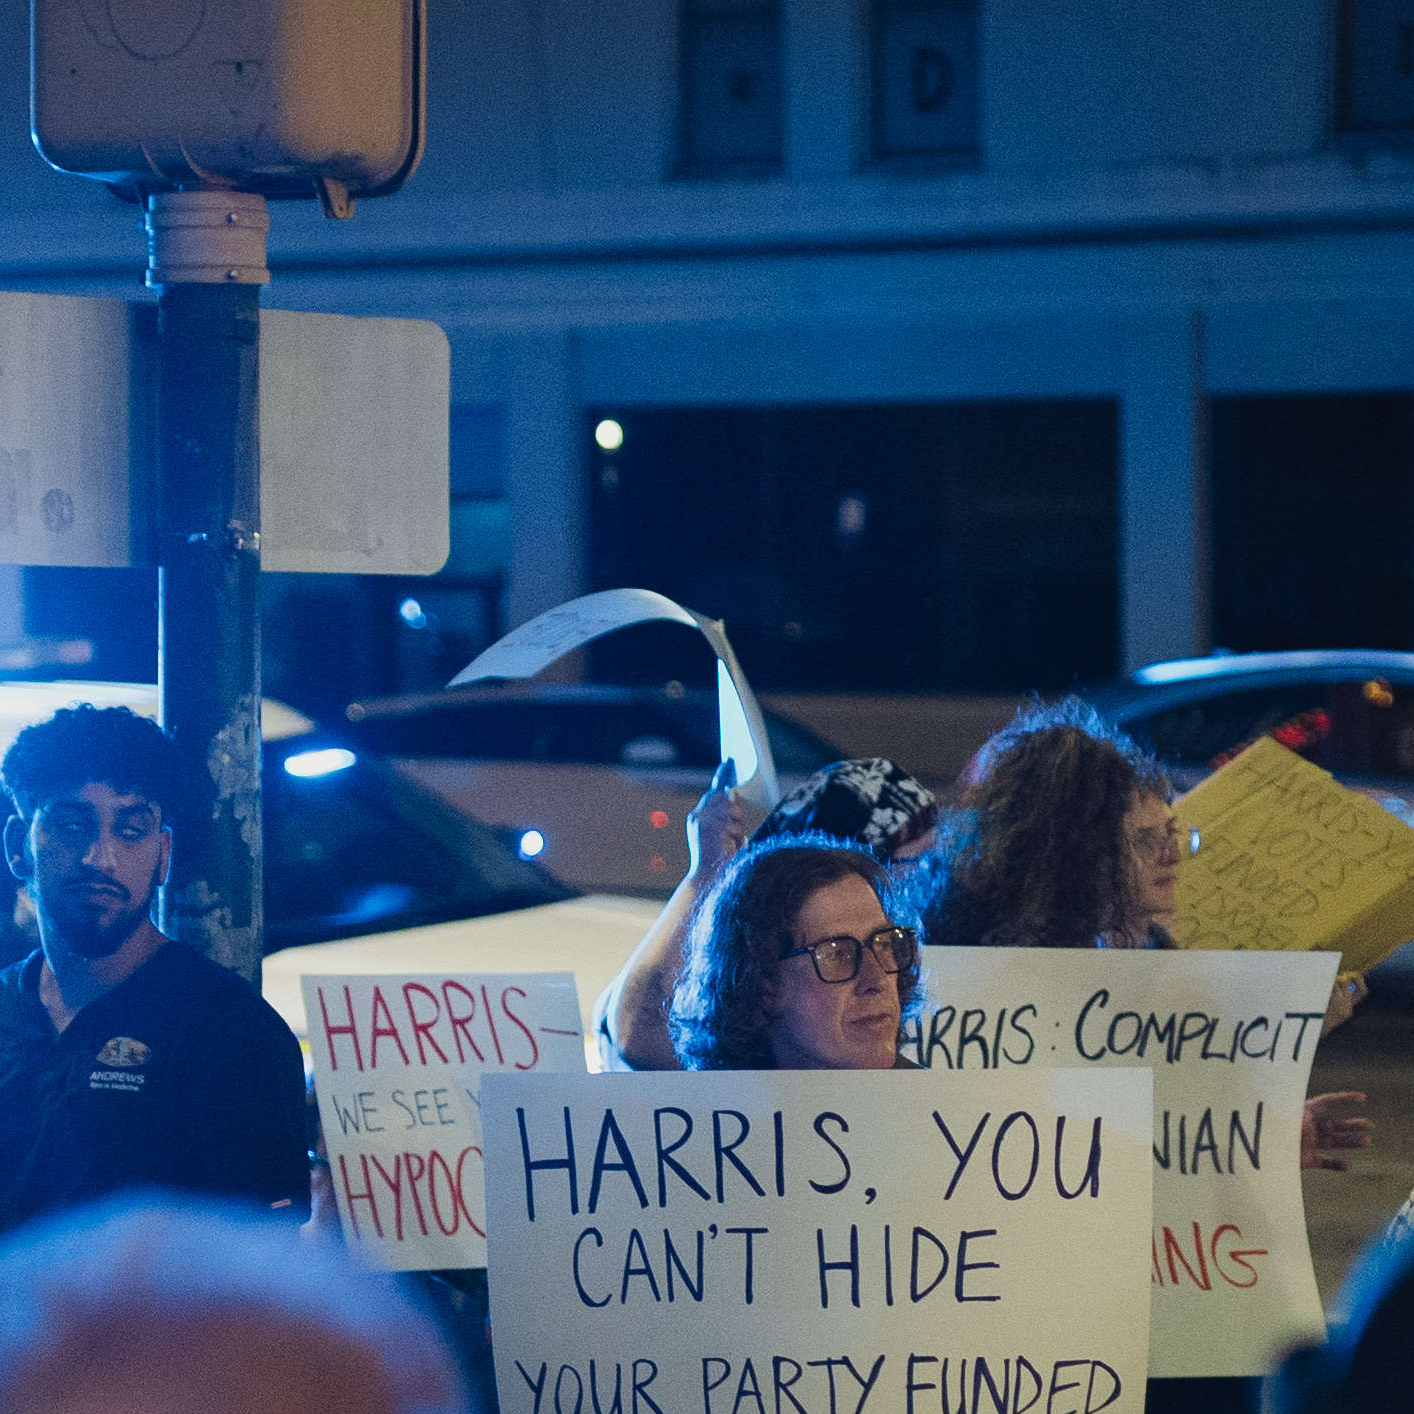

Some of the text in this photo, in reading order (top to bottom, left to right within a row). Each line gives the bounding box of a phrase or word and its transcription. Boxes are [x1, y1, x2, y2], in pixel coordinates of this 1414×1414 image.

[1074, 989, 1325, 1064] COMPLICIT
[332, 1090, 385, 1136] WE
[391, 1088, 455, 1130] SEE
[516, 1106, 1103, 1222] HARRIS, YOU
[573, 1223, 1002, 1309] CAN'T HIDE
